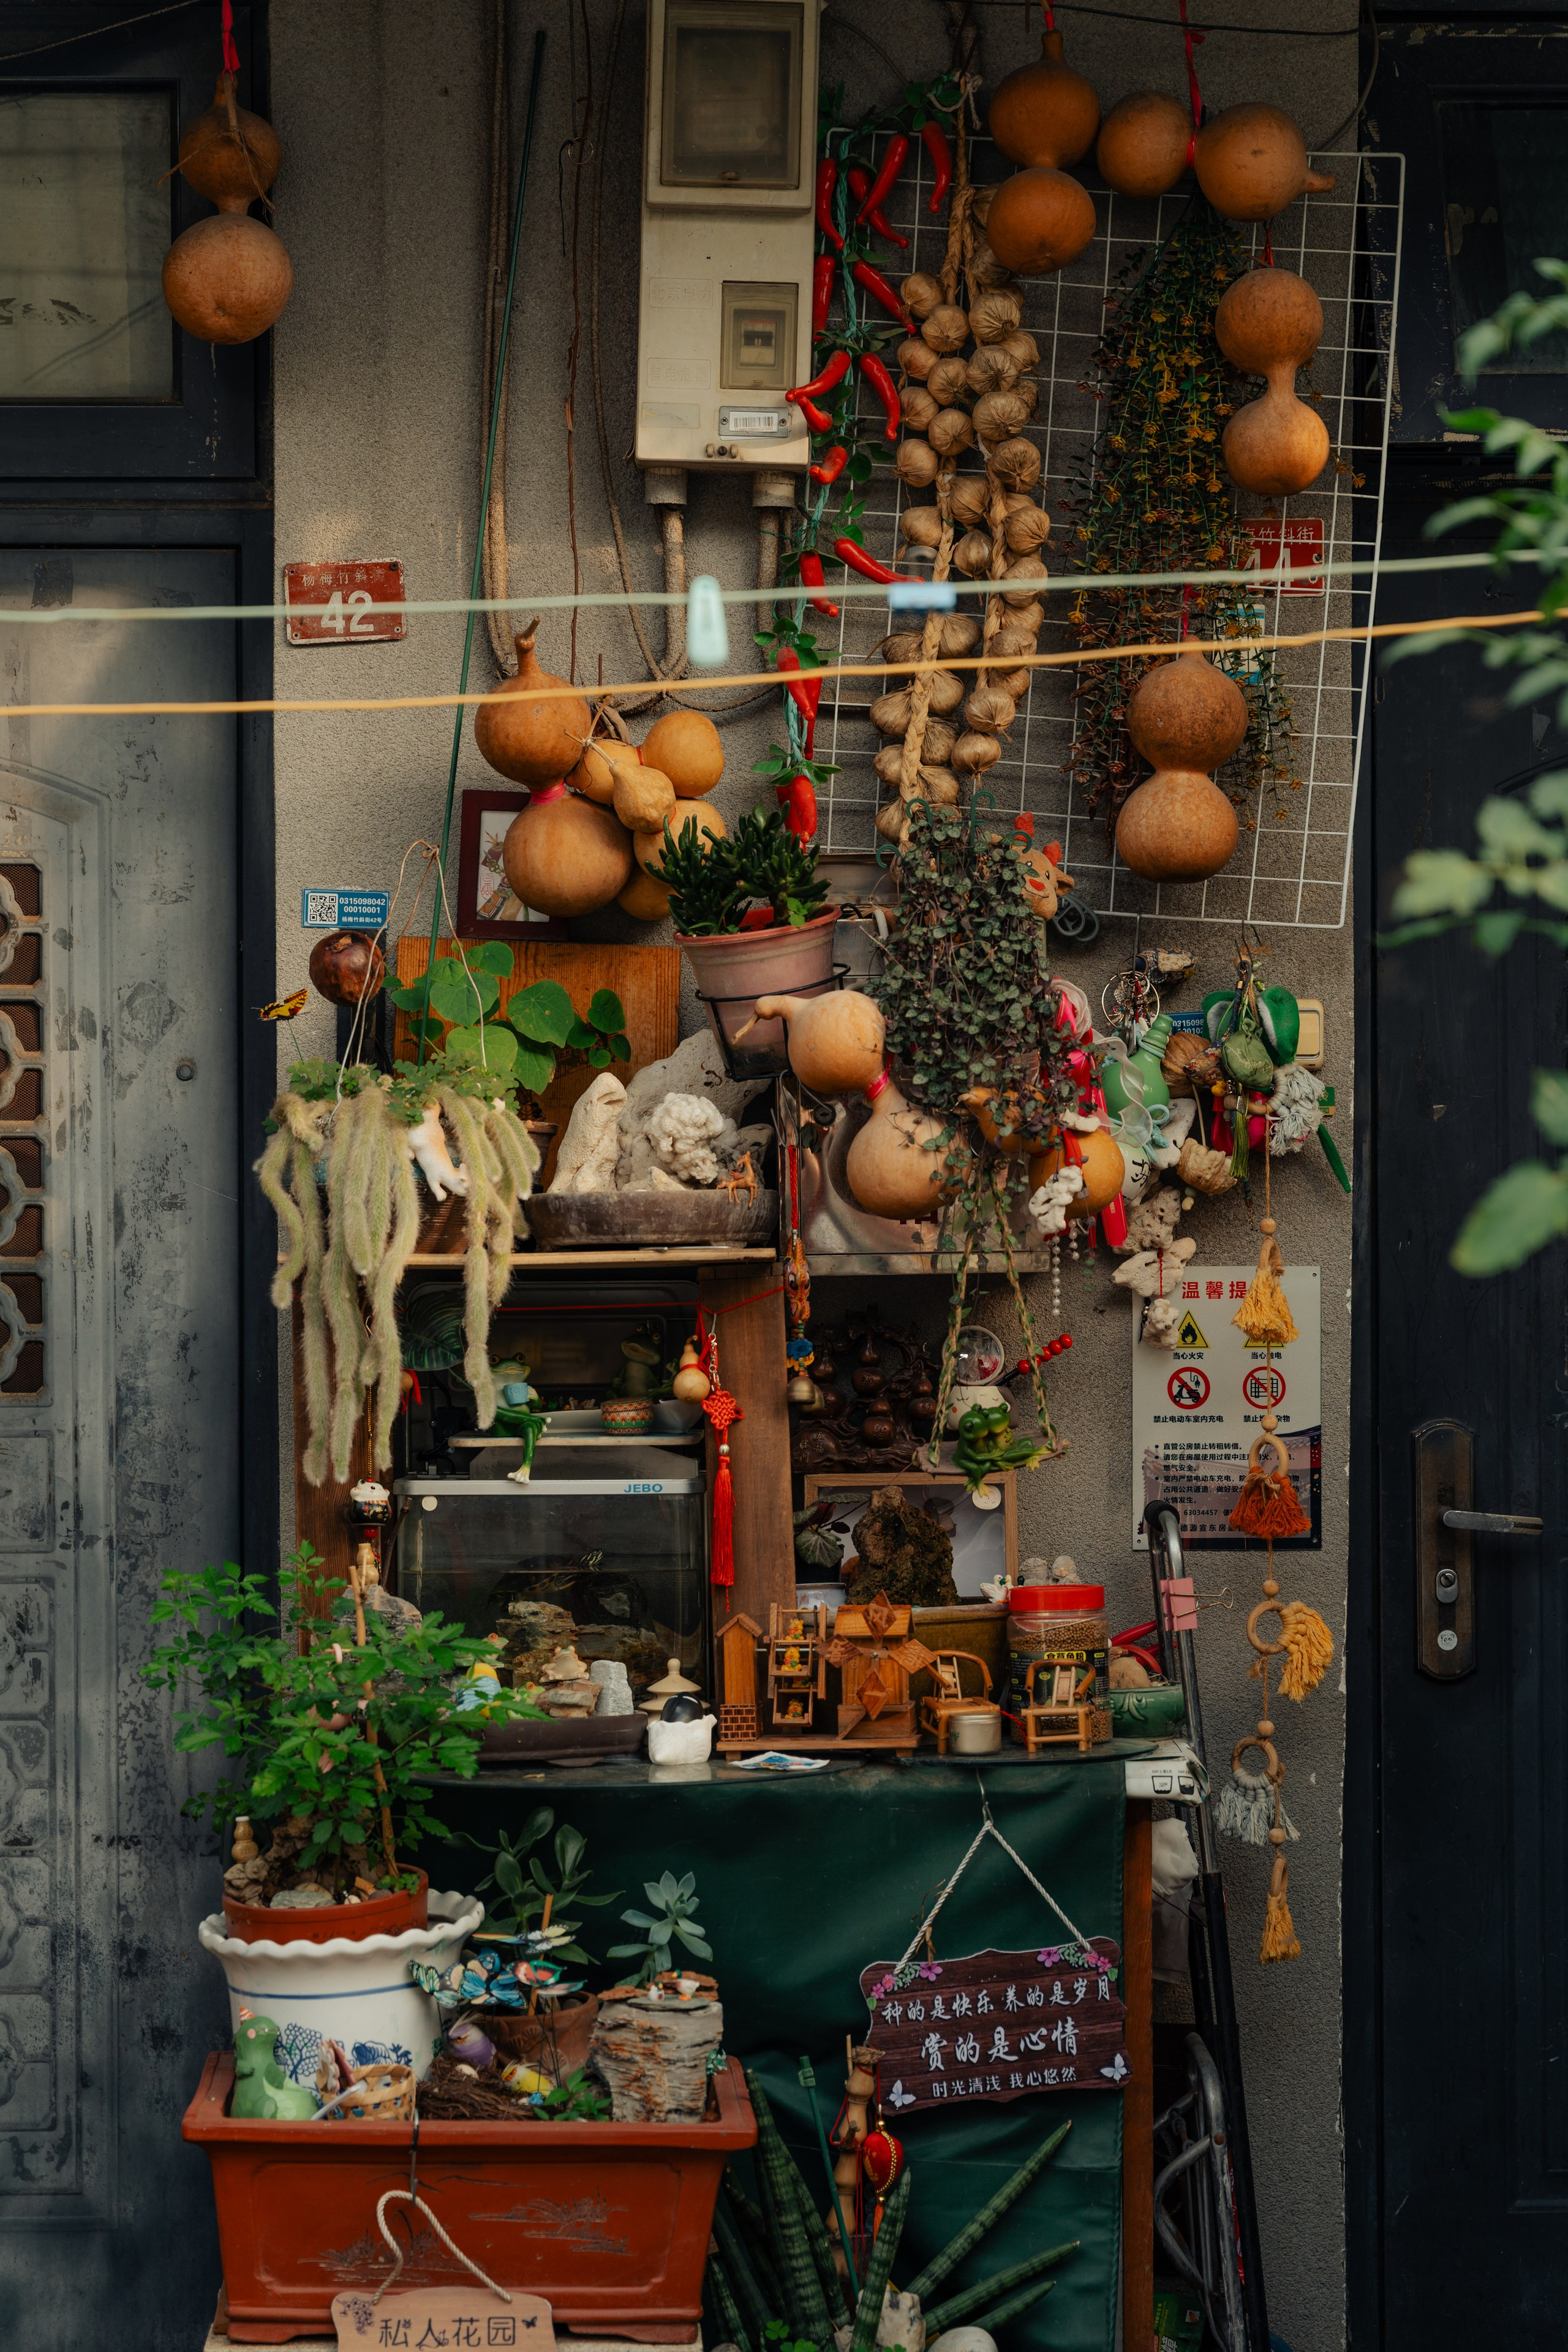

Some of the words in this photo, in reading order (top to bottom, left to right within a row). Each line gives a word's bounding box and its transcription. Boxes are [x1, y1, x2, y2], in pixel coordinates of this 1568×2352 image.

[320, 590, 374, 634] 42
[339, 897, 386, 906] 0315098042
[1172, 1019, 1204, 1027] 0315098
[1182, 1281, 1247, 1299] 温馨提
[1153, 1415, 1224, 1423] 禁止电动车室内充电
[1243, 1415, 1291, 1423] 禁止杂物
[624, 1483, 663, 1493] JEBO
[881, 1988, 994, 2027] 种的是快乐
[1001, 1975, 1110, 2013] 养的是岁月
[921, 2016, 1079, 2071] 赏的是心情
[932, 2075, 1001, 2098] 时光清浅
[1009, 2066, 1077, 2089] 我心悠然
[379, 2316, 515, 2350] 私人花园
